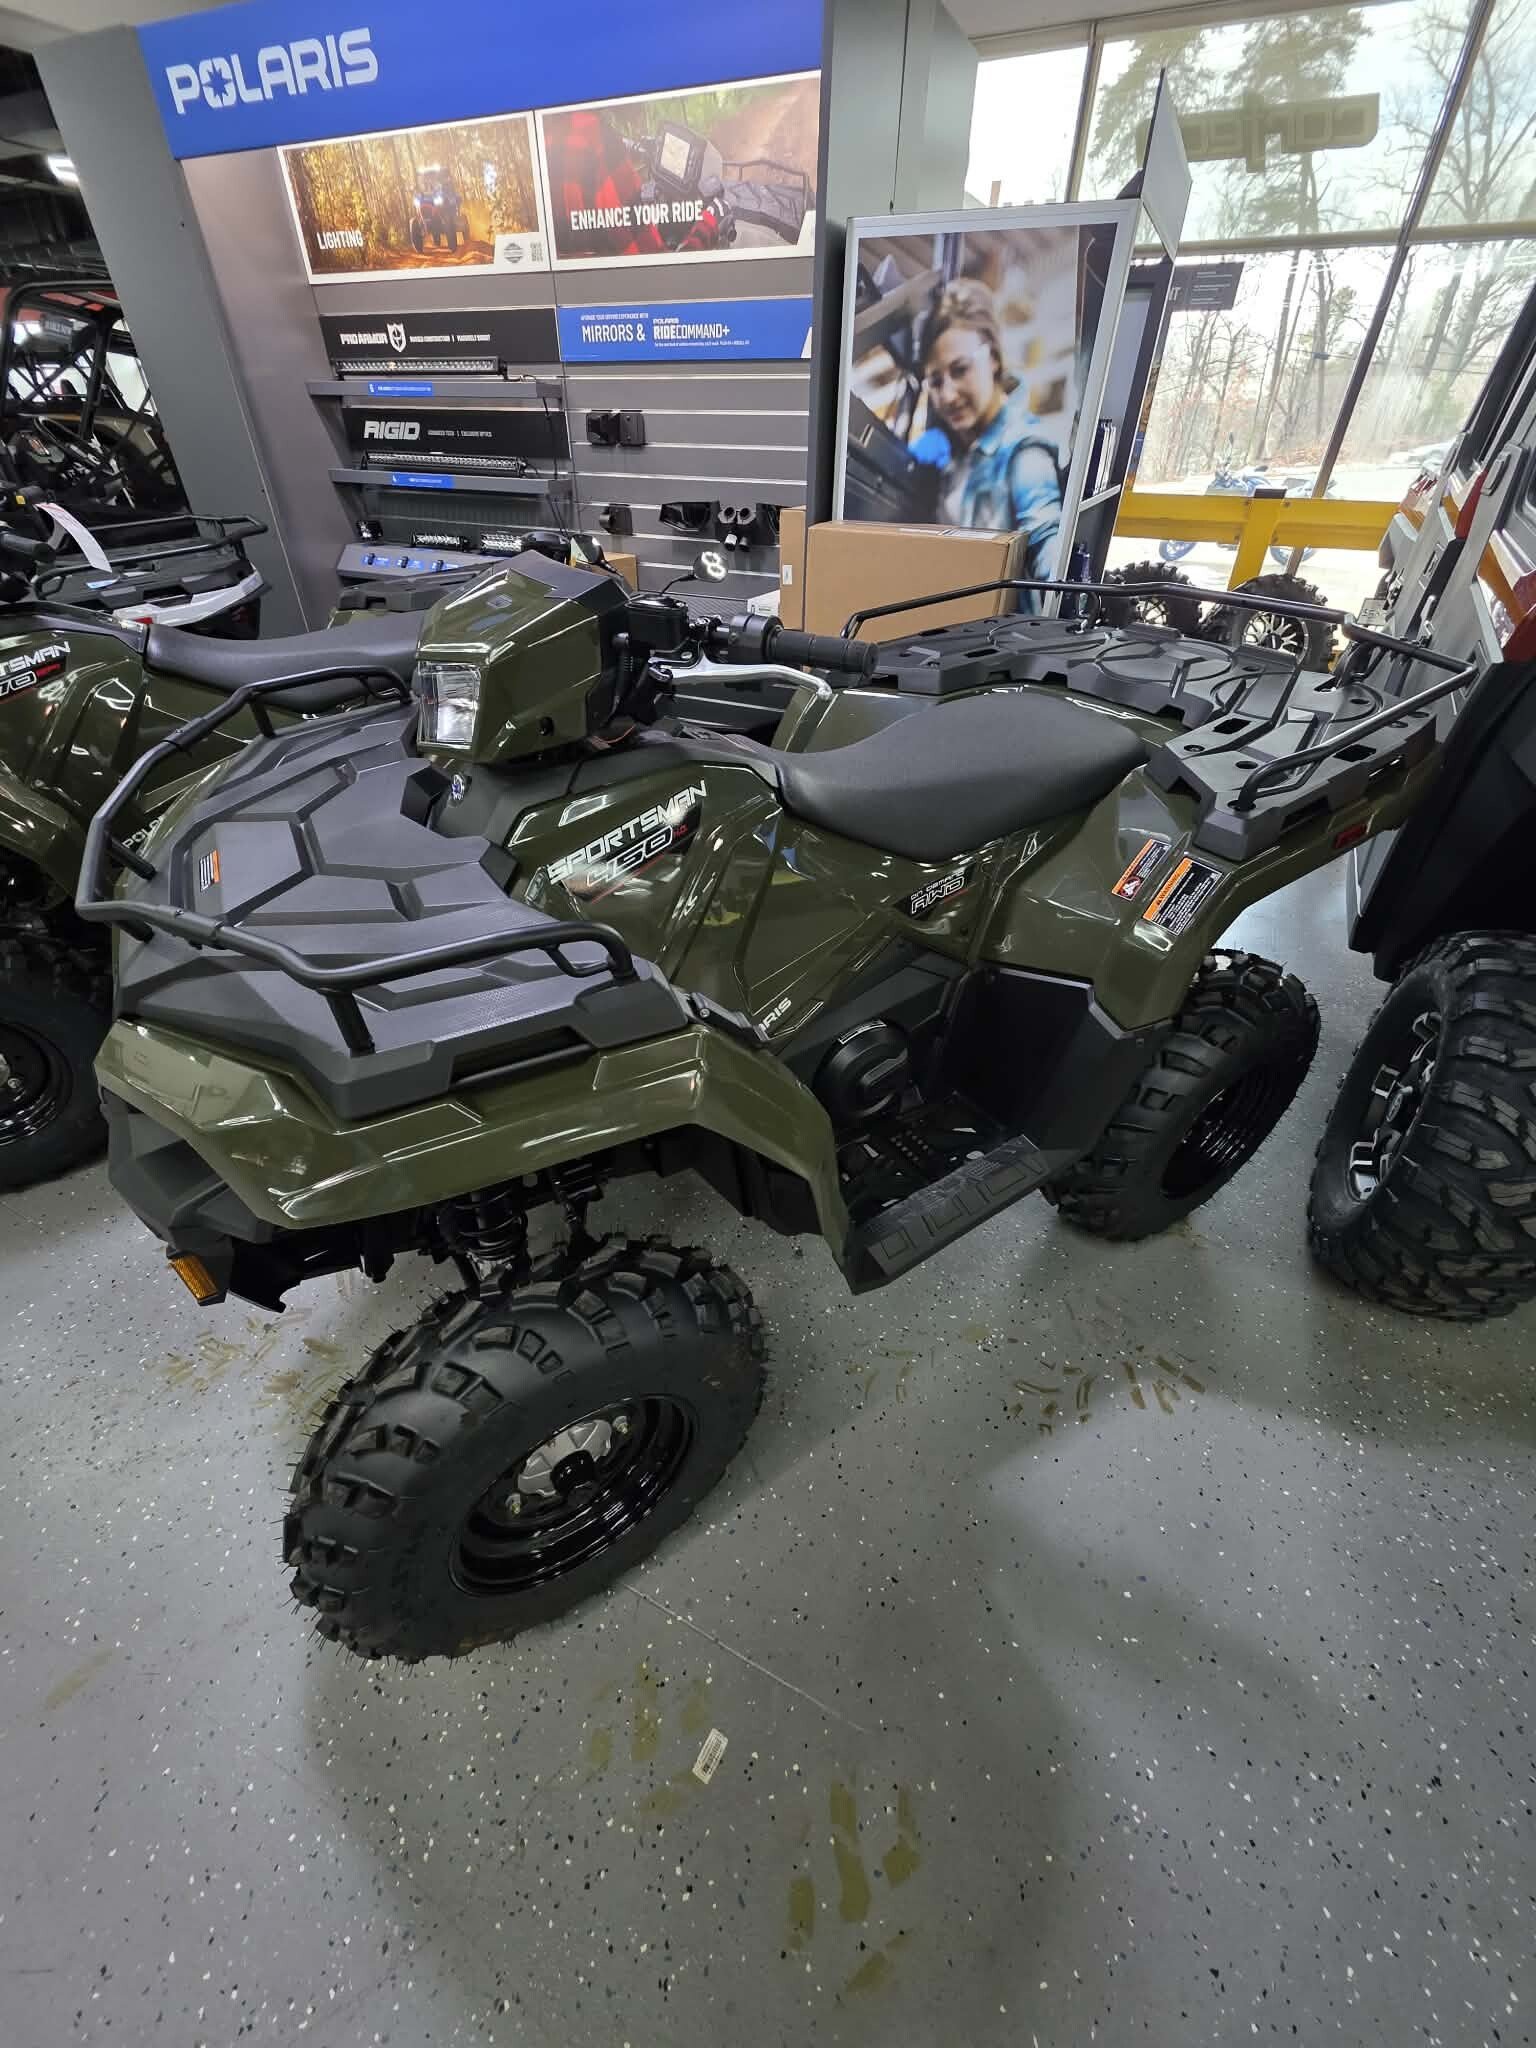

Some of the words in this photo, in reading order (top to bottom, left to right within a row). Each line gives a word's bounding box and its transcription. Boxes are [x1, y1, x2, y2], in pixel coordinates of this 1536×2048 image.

[165, 27, 379, 115] POLARIS
[570, 207, 632, 231] ENHANCE
[634, 202, 670, 226] YOUR
[671, 199, 704, 223] RIDE
[316, 229, 364, 250] LIGHTING
[582, 323, 634, 343] MIRRORS
[636, 323, 646, 342] &
[363, 420, 420, 440] RIGID
[547, 779, 707, 886] SPORTSMAN
[587, 824, 673, 887] 450
[911, 876, 965, 914] AWD
